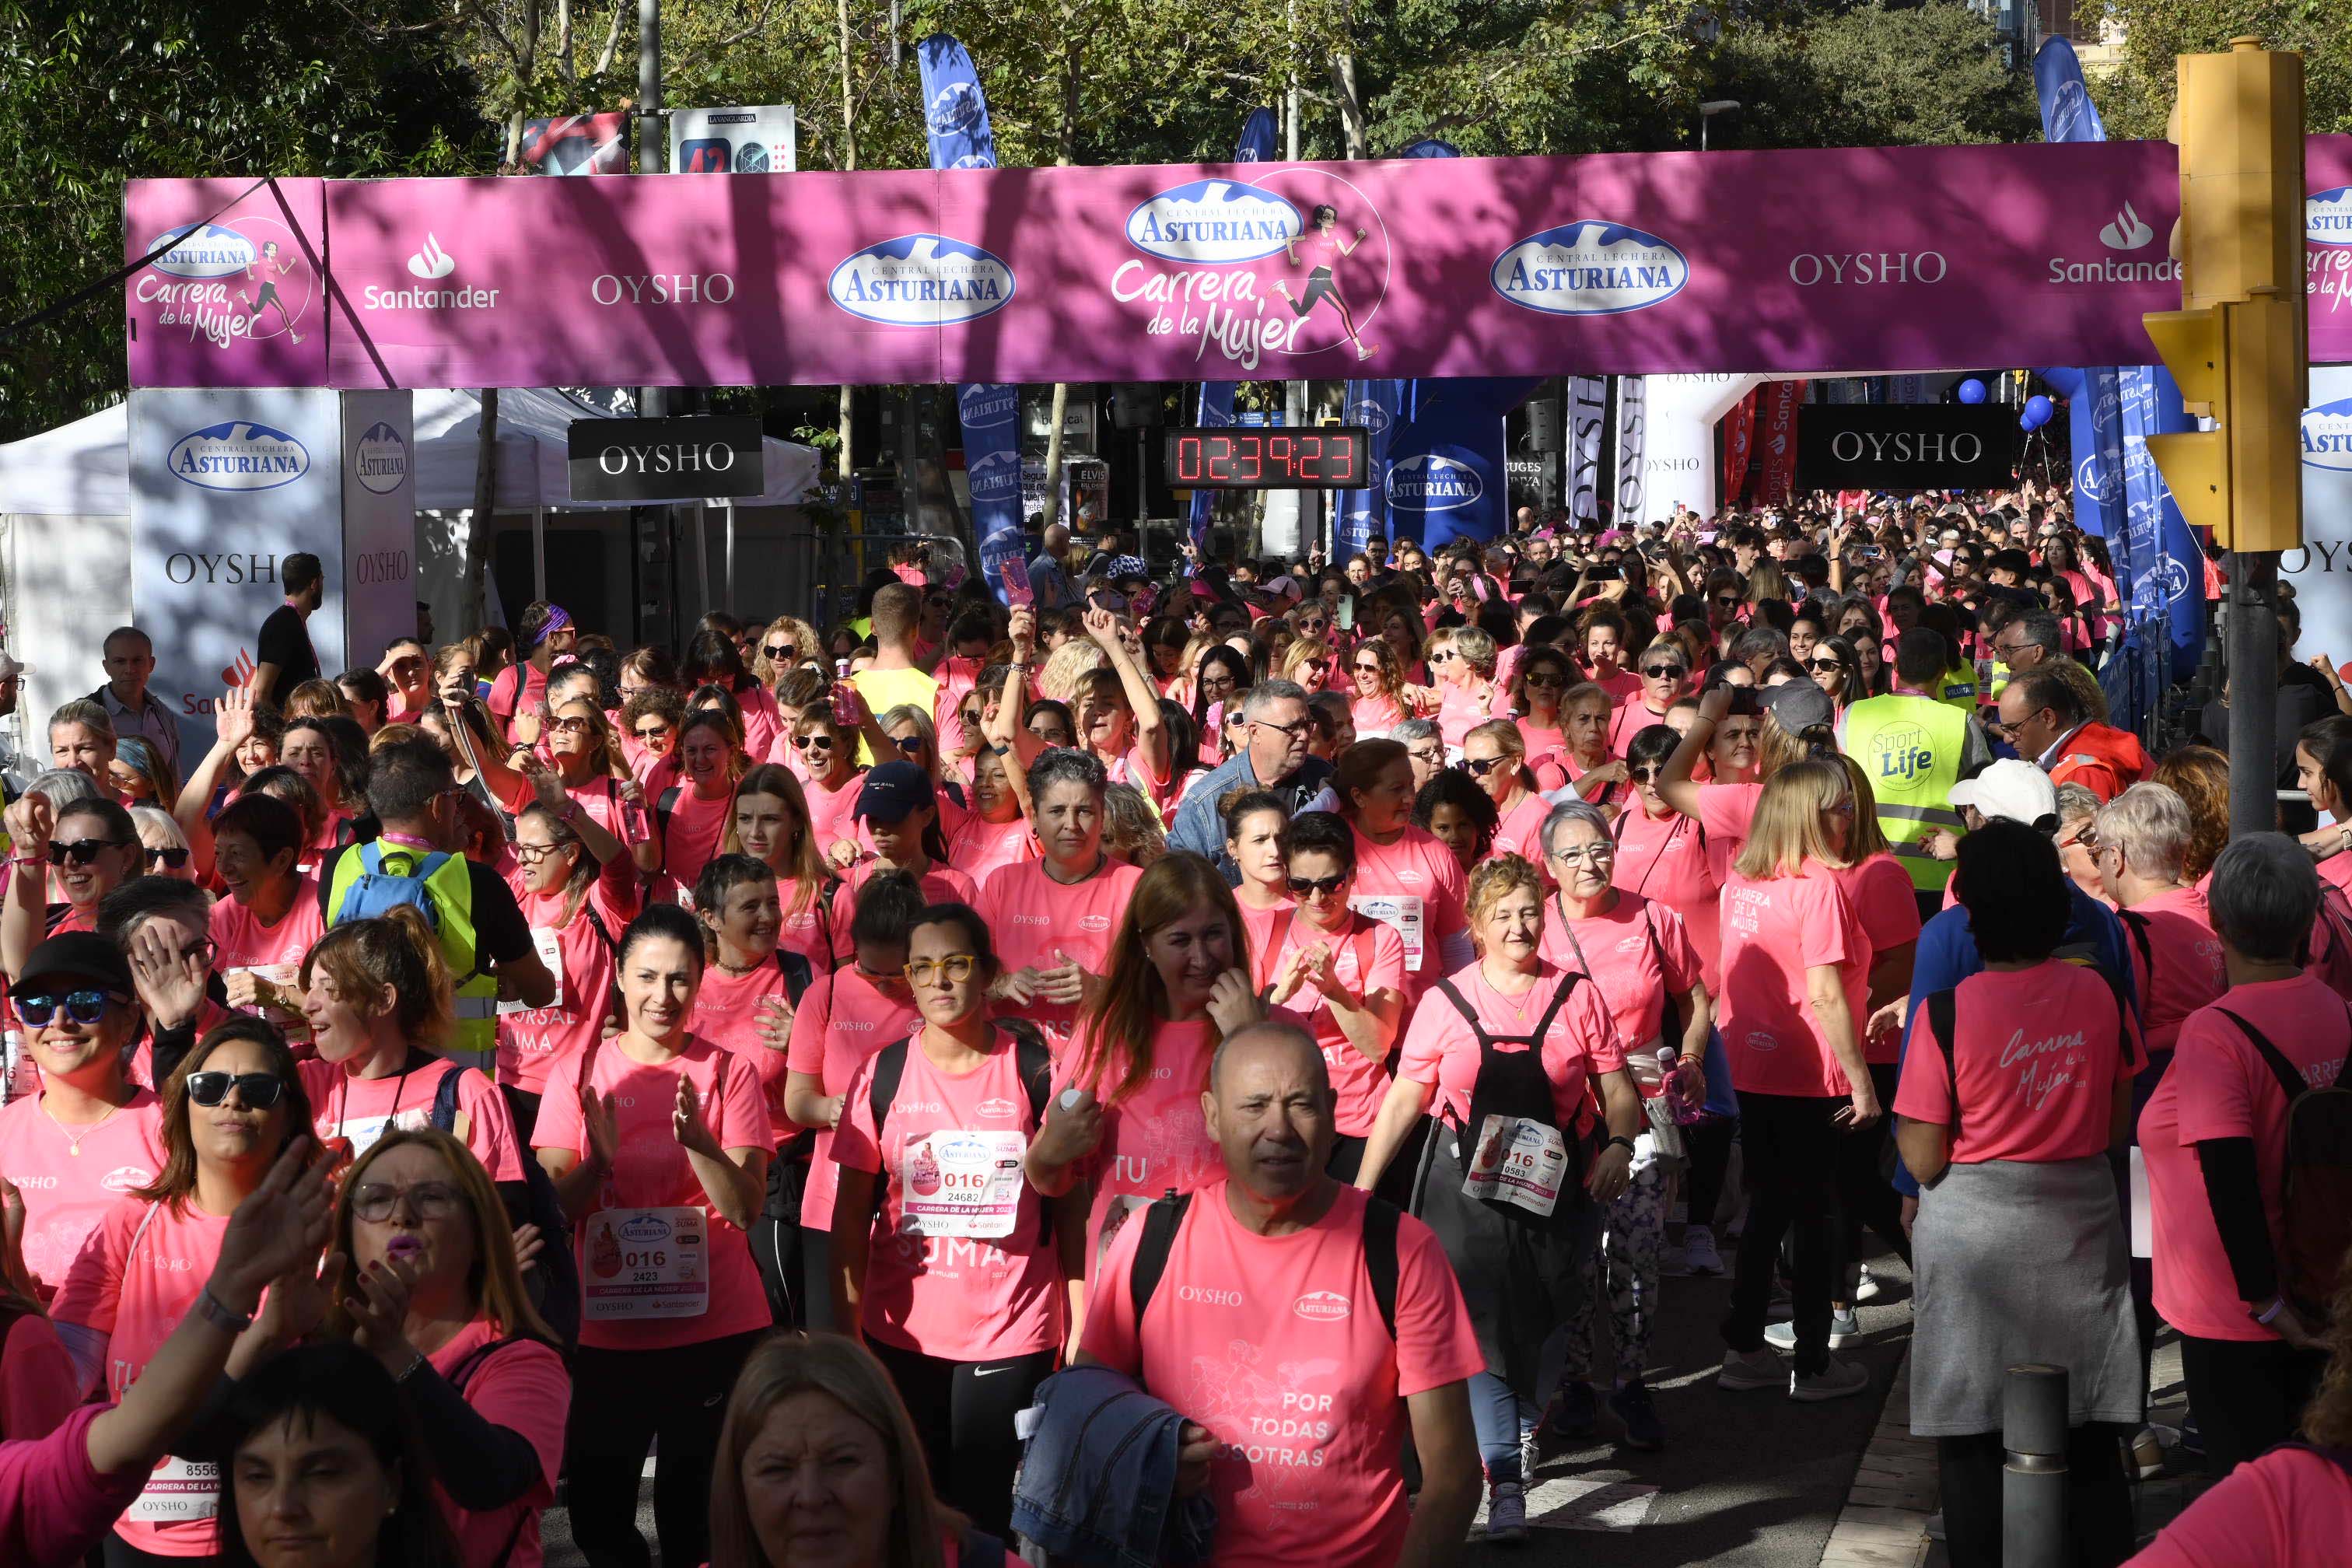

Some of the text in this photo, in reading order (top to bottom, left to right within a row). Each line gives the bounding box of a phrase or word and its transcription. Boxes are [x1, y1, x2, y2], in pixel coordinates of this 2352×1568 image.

[1167, 208, 1221, 219] CENTRAL
[1139, 212, 1288, 243] ASTURIANA
[871, 264, 995, 275] CENTRAL LECHERA
[1536, 252, 1667, 263] CENTRAL LECHERA
[1790, 251, 1947, 286] OYSHO
[1111, 259, 1255, 303] Carrera
[1506, 256, 1673, 292] ASTURIANA
[2048, 257, 2182, 283] Santande
[136, 275, 227, 303] Carrera
[591, 273, 734, 305] OYSHO
[843, 268, 1001, 303] ASTURIANA
[2321, 273, 2335, 294] la
[364, 285, 499, 310] Santander
[159, 301, 262, 349] de la Mujer
[1147, 299, 1311, 370] de la Mujer
[1774, 381, 1794, 431] Santa
[1573, 375, 1604, 521] OYSH
[1620, 375, 1643, 513] OYSH
[1832, 431, 1982, 464] OYSHO
[179, 447, 300, 474] ASTURIANA
[359, 449, 404, 476] ASTURIANA
[599, 441, 735, 475] OYSHO
[1178, 436, 1353, 479] 02:39:23
[1081, 471, 1104, 480] ELVIS
[1769, 457, 1783, 502] ports
[1388, 477, 1475, 499] ASTURIANA
[1024, 502, 1043, 512] mete
[165, 553, 276, 584] OYSH
[357, 550, 408, 585] OYSHO
[183, 693, 215, 715] Sa
[1873, 727, 1923, 754] Sport
[1881, 746, 1932, 779] Life
[1731, 885, 1771, 909] CARRERA
[1013, 915, 1050, 926] OYSHO
[1734, 901, 1757, 919] DE LA
[1731, 913, 1759, 934] MUJER
[2195, 940, 2225, 957] CARR
[514, 1008, 576, 1026] ORSAL
[834, 1020, 875, 1032] OYSHO
[506, 1027, 553, 1051] SUMA
[2000, 1027, 2088, 1069] Carrera
[2300, 1058, 2347, 1086] ARRE
[2016, 1059, 2075, 1111] Mujer
[1114, 1154, 1146, 1184] TU
[1501, 1148, 1534, 1167] 016
[12, 1177, 57, 1189] YSHO
[944, 1173, 984, 1188] 016
[1504, 1167, 1526, 1178] 0583
[1516, 1179, 1535, 1190] MUJER
[947, 1192, 979, 1202] 24682
[1517, 1192, 1547, 1208] Santander
[675, 1218, 698, 1227] SUMA
[913, 1220, 949, 1229] OYSHO
[625, 1251, 666, 1268] 016
[633, 1272, 658, 1282] 2423
[597, 1302, 634, 1312] OYSHO
[662, 1300, 700, 1308] Santander
[1179, 1285, 1242, 1307] OYSHO
[1297, 1302, 1349, 1314] ASTURIANA
[1283, 1391, 1333, 1412] POR
[1249, 1416, 1329, 1440] TODAS
[1213, 1443, 1325, 1468] OSOTRAS
[142, 1500, 187, 1511] OYSHO
